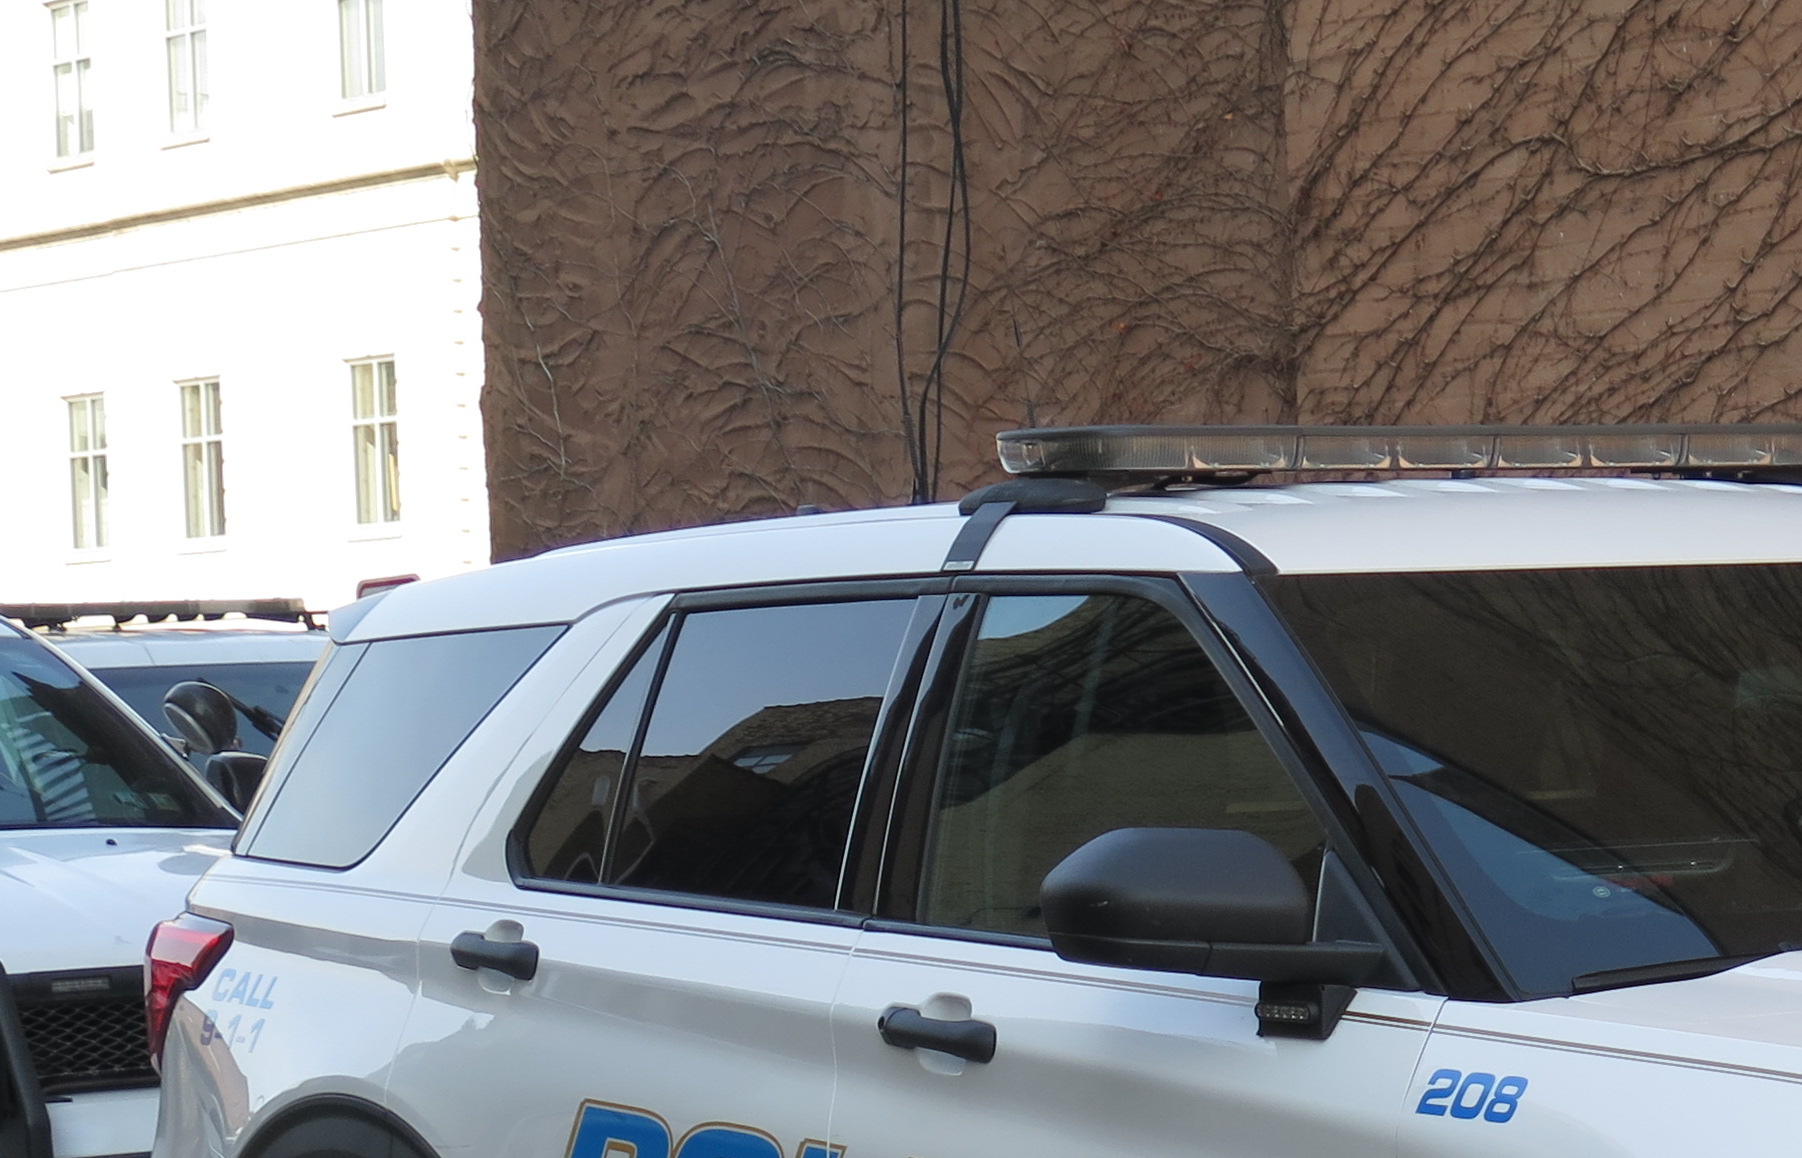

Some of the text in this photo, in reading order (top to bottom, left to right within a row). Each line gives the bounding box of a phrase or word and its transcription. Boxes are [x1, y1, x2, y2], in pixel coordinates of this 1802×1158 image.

[212, 967, 279, 1010] CALL
[201, 1009, 266, 1053] 9-1-1
[1415, 1068, 1529, 1123] 208
